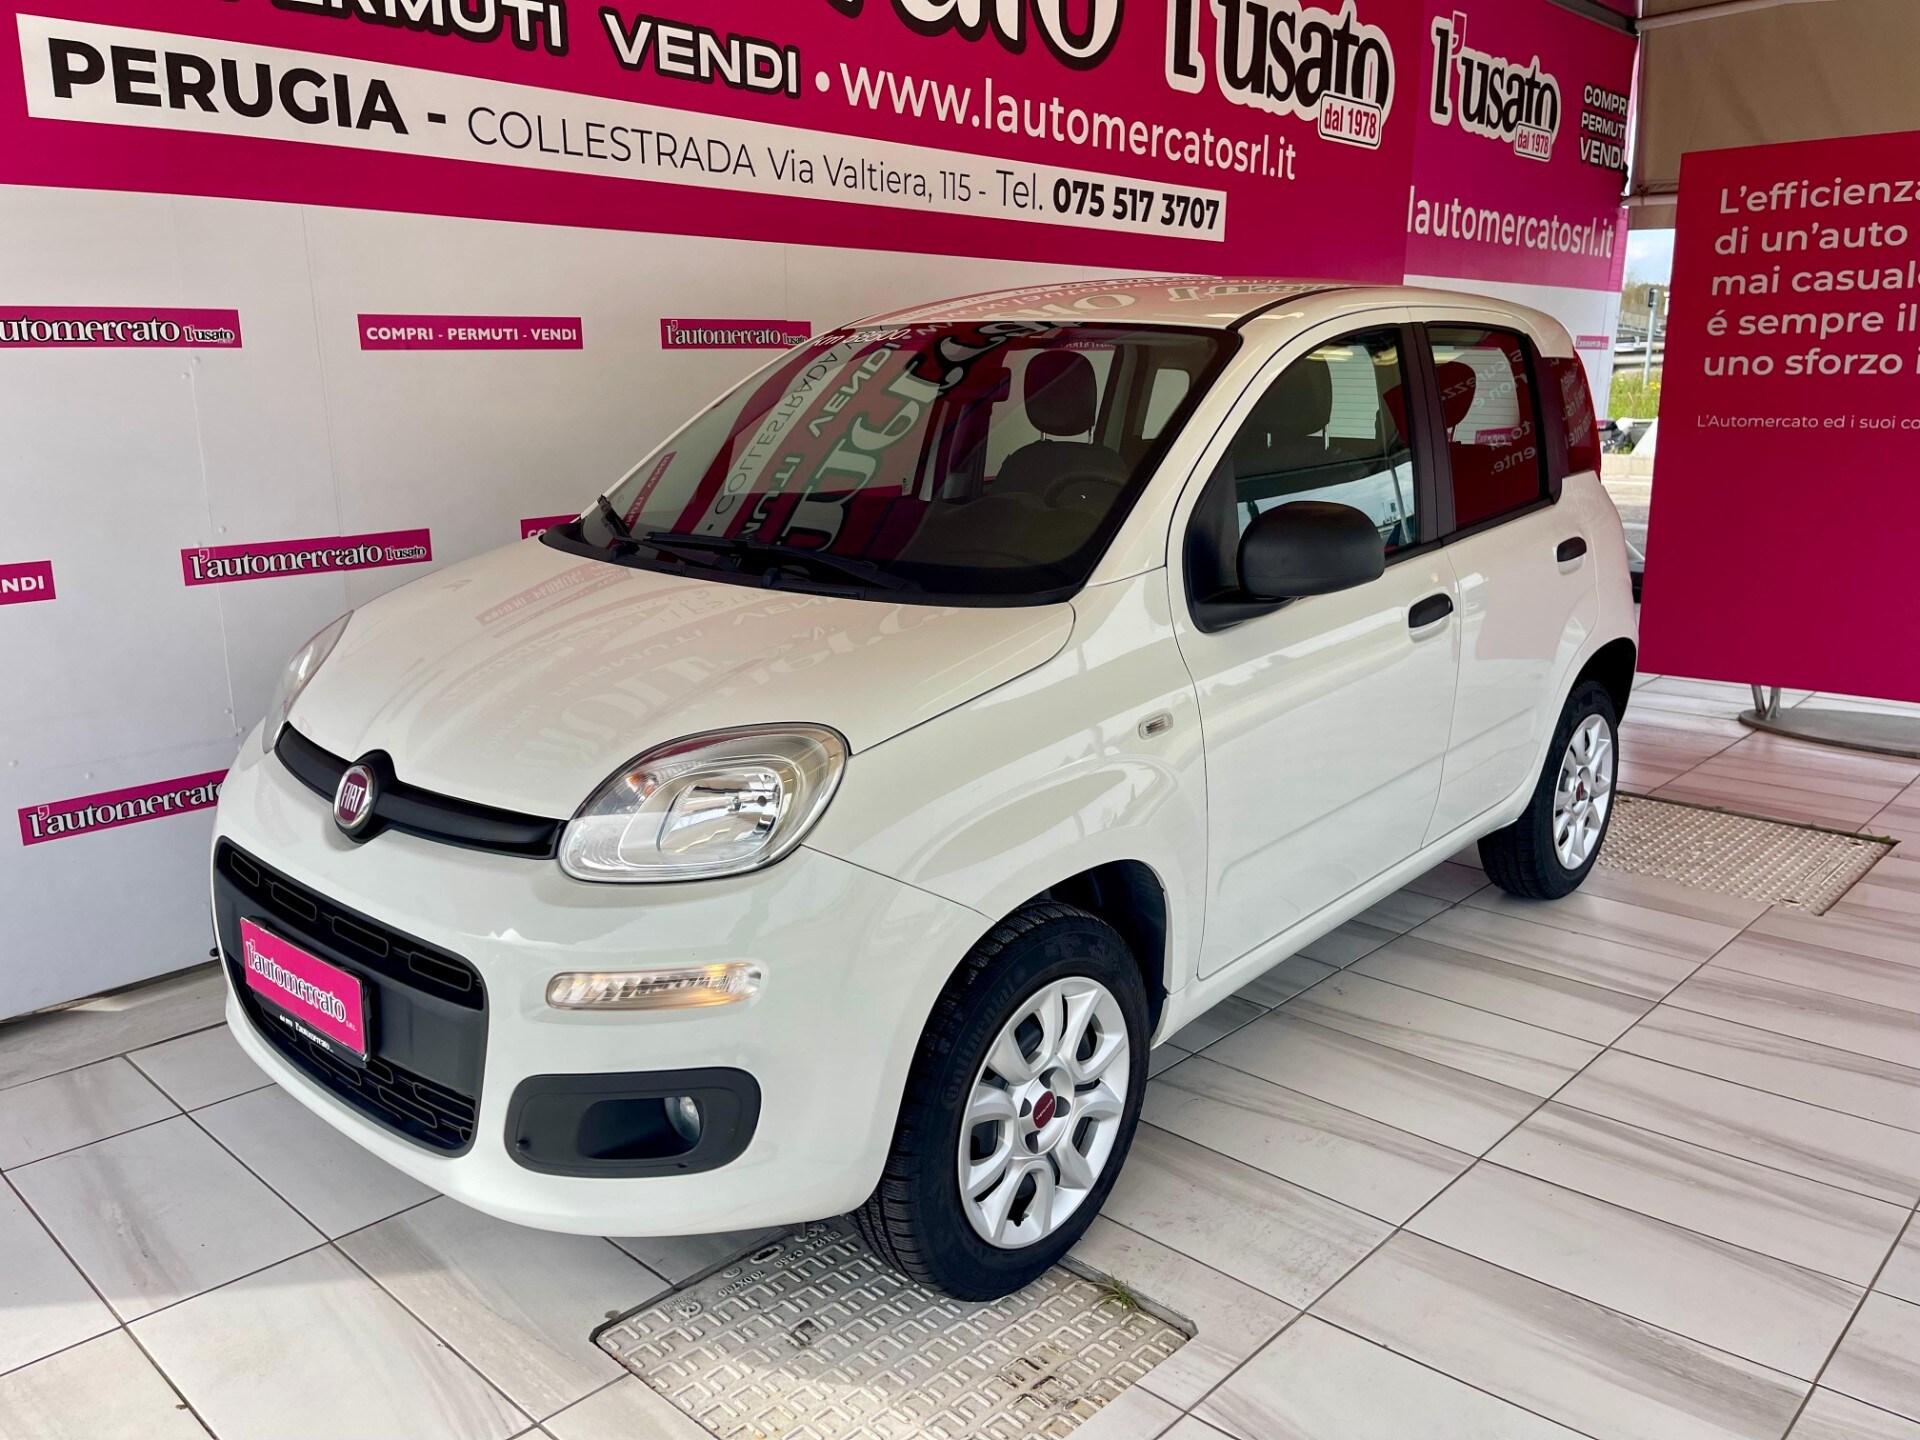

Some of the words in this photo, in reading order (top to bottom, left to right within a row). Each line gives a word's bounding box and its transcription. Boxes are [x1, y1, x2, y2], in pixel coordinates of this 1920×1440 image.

[603, 12, 798, 95] VENDI
[1432, 10, 1559, 137] l'usato
[48, 37, 410, 135] PERUGIA
[468, 106, 756, 178] COLLESTRADA
[767, 146, 814, 185] Via
[822, 153, 933, 204] Valtiera,
[939, 171, 972, 202] 115
[995, 169, 1043, 212] Tel.
[1052, 177, 1105, 218] 075
[1112, 186, 1155, 223] 517
[1159, 192, 1220, 230] 3707
[838, 61, 1298, 181] www.lautomercatosrl.it
[1324, 102, 1344, 132] dal
[1347, 107, 1377, 139] 1978
[1517, 128, 1529, 150] dal
[1531, 133, 1549, 155] 1978
[1579, 135, 1625, 170] VENDI
[1719, 177, 1920, 214] L'efficienz
[1406, 185, 1615, 259] lautomercatosrl.it
[1714, 225, 1749, 255] di
[1760, 222, 1909, 252] un'auto
[1711, 265, 1781, 296] mai
[1791, 260, 1920, 293] casual
[366, 327, 434, 341] COMPRI
[447, 328, 519, 341] PERMUTI
[530, 328, 577, 341] VENDI
[665, 319, 781, 345] l'automercato
[1737, 310, 1885, 341] sempre
[1896, 302, 1918, 332] il
[1703, 355, 1775, 376] uno
[1784, 347, 1903, 376] sforzo
[1696, 414, 1819, 429] L'Automercato
[1823, 414, 1846, 429] ed
[1850, 414, 1856, 429] i
[1859, 415, 1896, 430] suoi
[0, 575, 45, 594] NDI
[340, 781, 366, 813] FIAT
[245, 938, 347, 1023] l'automercato
